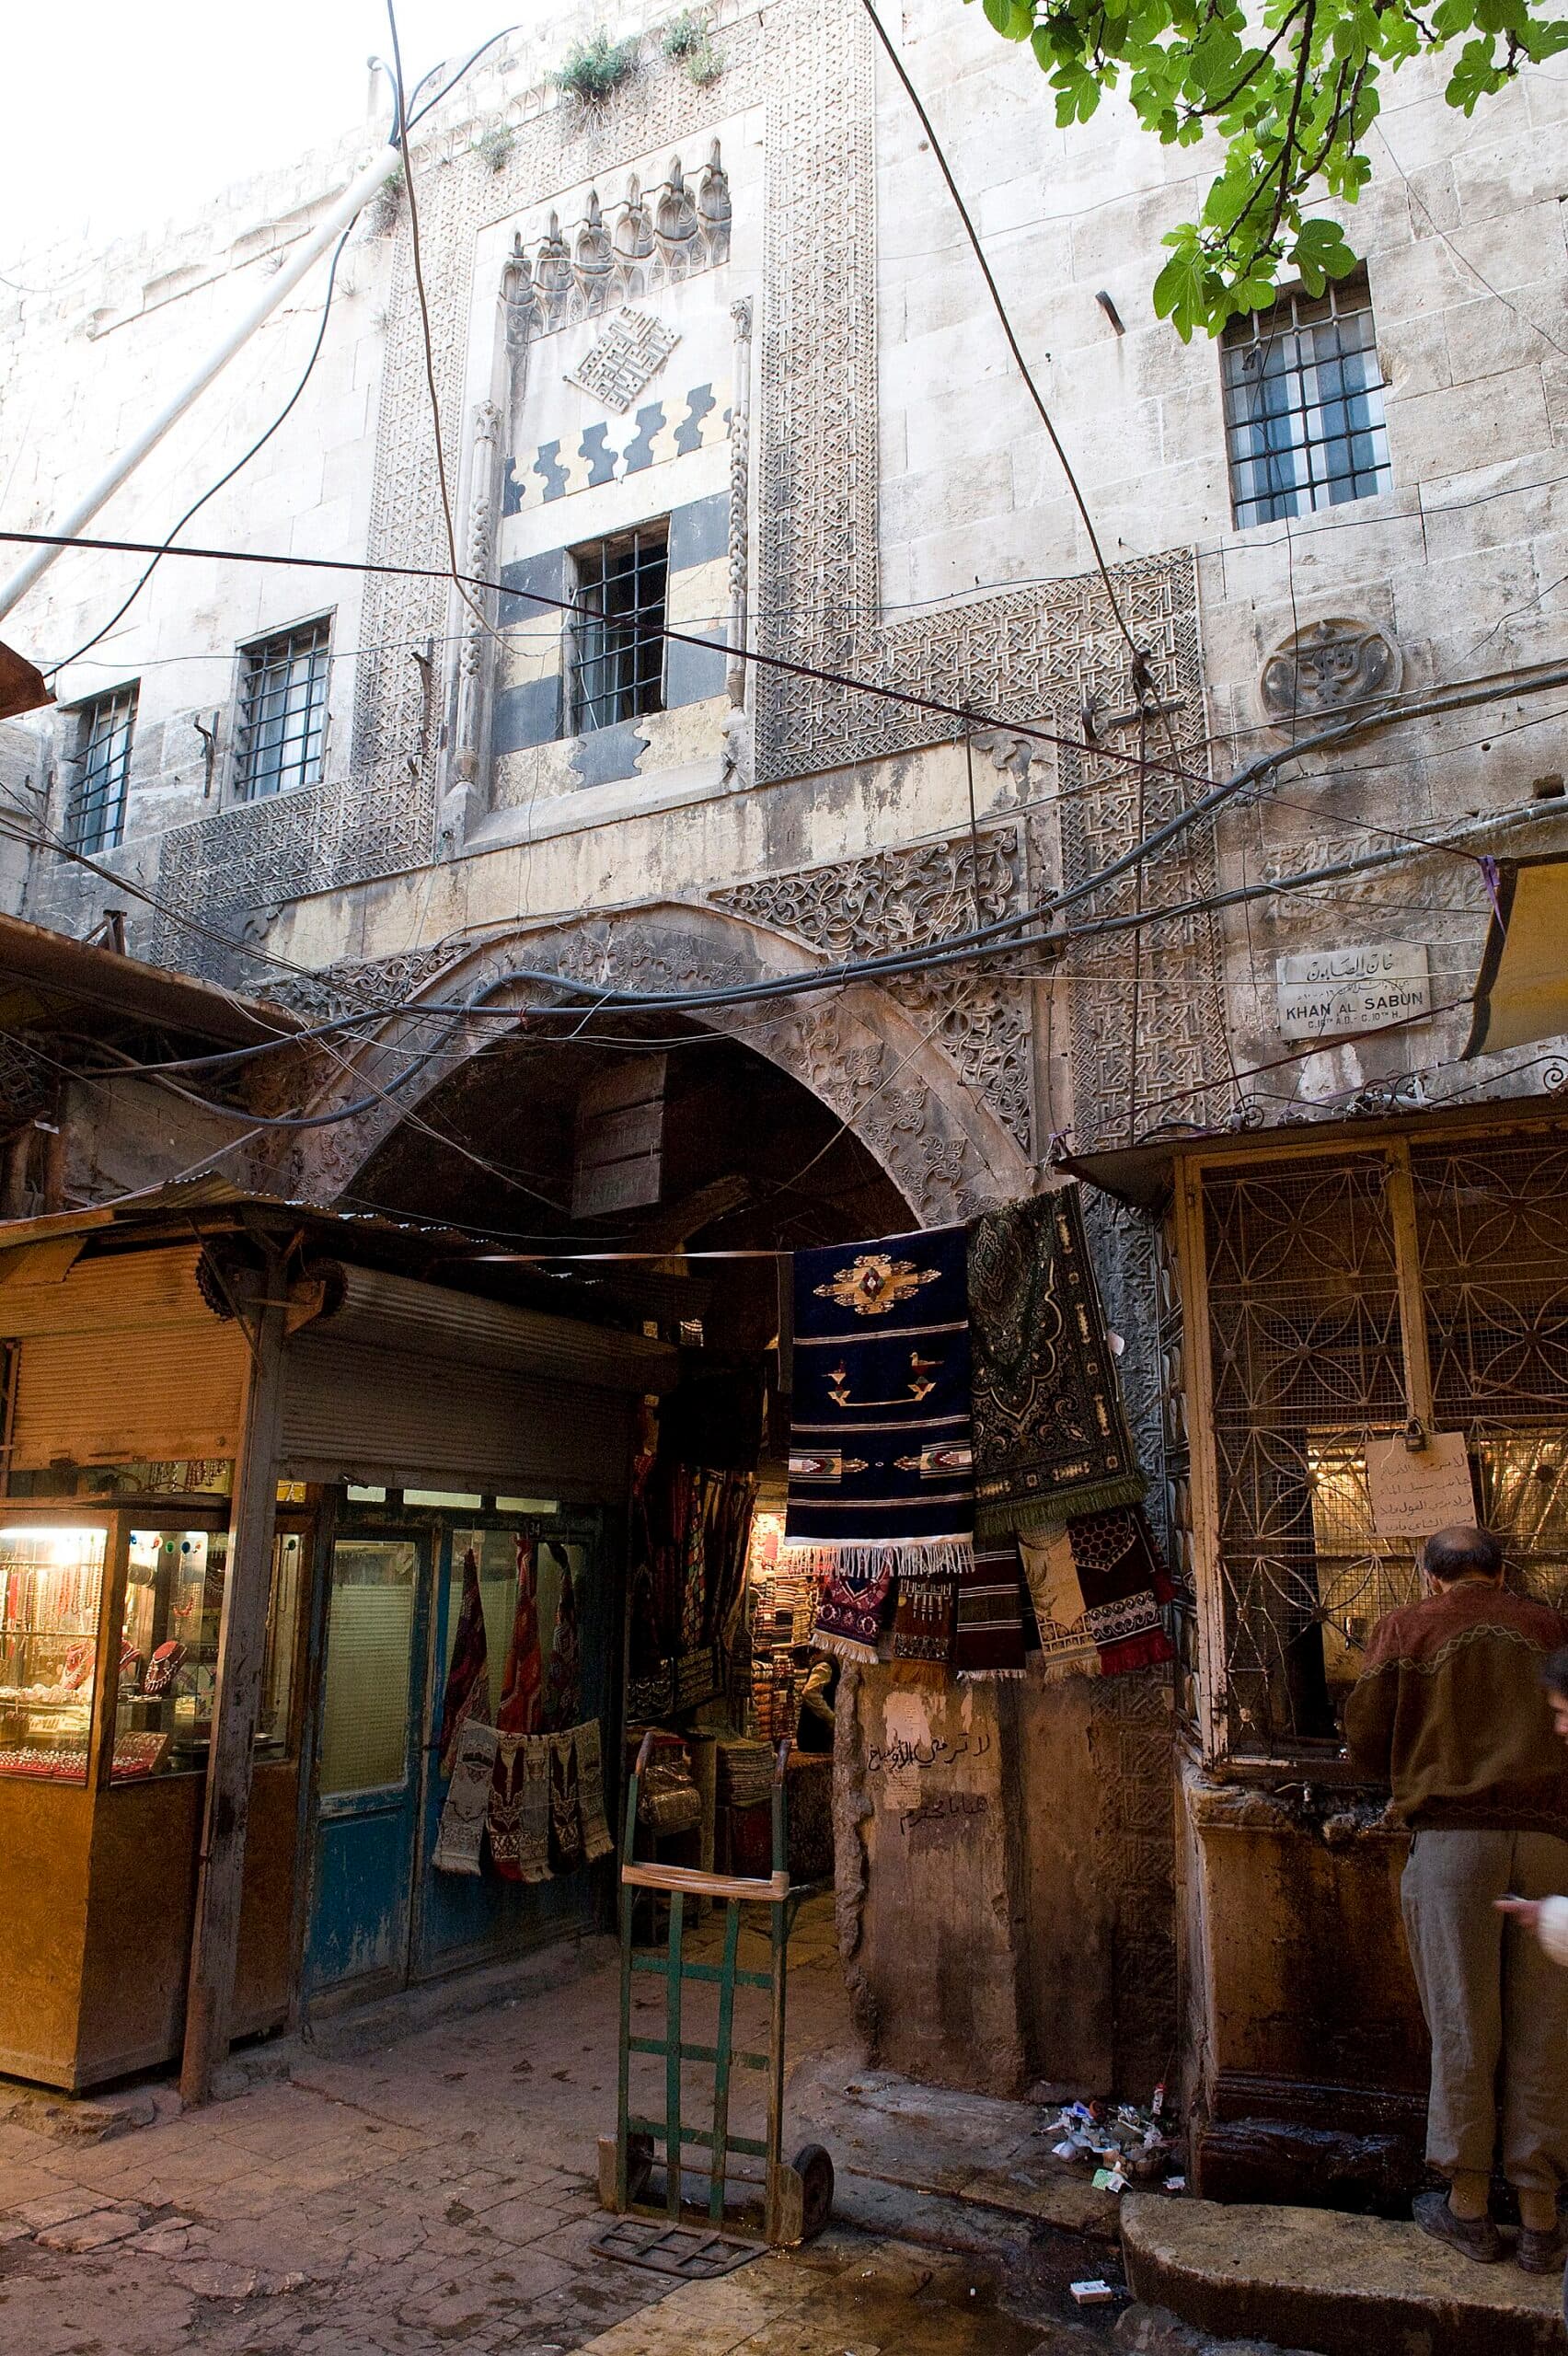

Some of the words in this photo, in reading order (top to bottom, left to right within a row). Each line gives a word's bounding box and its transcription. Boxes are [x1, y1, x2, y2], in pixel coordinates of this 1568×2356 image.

[1366, 953, 1393, 974] خان
[1286, 1002, 1331, 1020] KHAN
[1339, 1003, 1356, 1013] AL
[1365, 992, 1423, 1010] SABUN
[973, 1734, 991, 1757] لا
